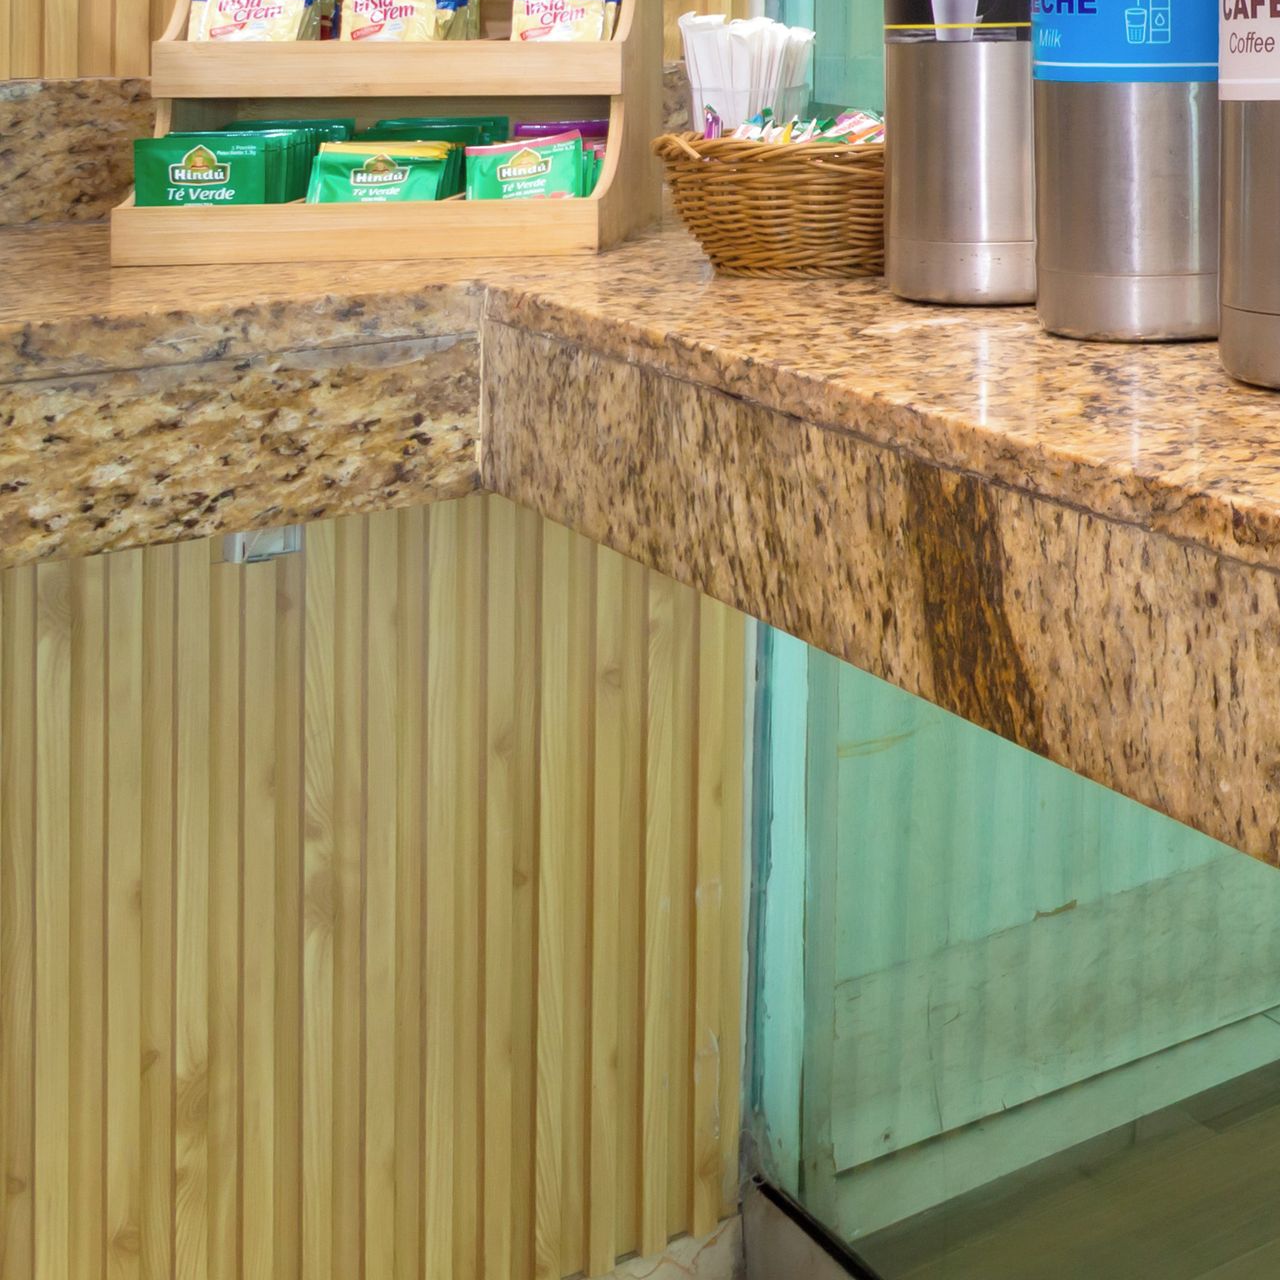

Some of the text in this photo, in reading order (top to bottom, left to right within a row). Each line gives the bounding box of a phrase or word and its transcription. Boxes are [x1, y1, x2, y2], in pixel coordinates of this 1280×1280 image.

[1040, 28, 1062, 48] Milk
[1229, 32, 1275, 54] Coffee
[174, 168, 225, 181] Hindú
[355, 172, 404, 183] Hindú
[167, 187, 235, 201] Té Verde
[368, 186, 401, 196] Verde
